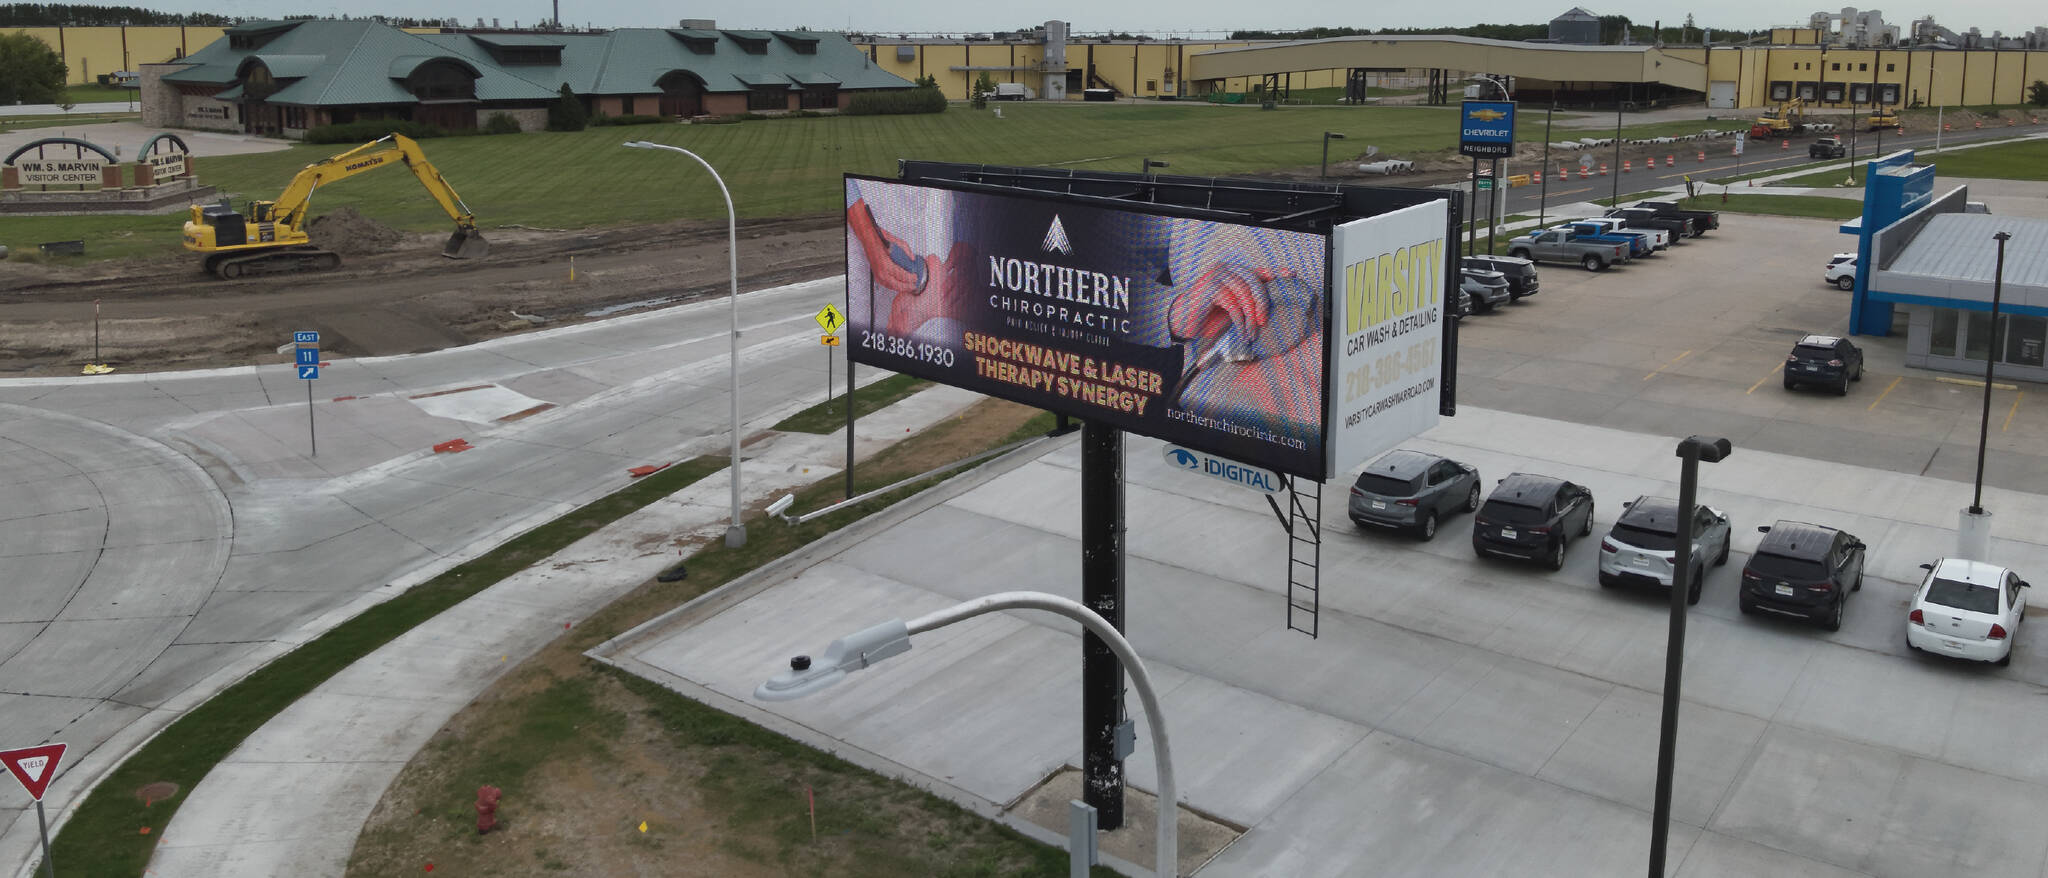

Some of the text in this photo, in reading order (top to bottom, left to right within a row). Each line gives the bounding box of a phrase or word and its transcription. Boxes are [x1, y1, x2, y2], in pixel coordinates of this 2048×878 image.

[1464, 129, 1509, 137] CHEVROLET
[1464, 145, 1507, 153] NEIGHBORS
[22, 163, 100, 172] WM. S. MARVIN
[26, 174, 97, 182] VISITOR CENTER
[345, 157, 384, 171] KOMATSU
[989, 255, 1131, 313] NORTHERN
[1346, 239, 1442, 335] VARSITY
[990, 294, 1131, 334] CHIROPRACTIC
[297, 333, 315, 341] EAST
[862, 330, 954, 368] 218.386.1930
[1347, 307, 1437, 357] CAR WASH & DETAILING
[303, 351, 312, 362] 11
[964, 332, 1163, 395] SHOCKWAVE & LASER
[975, 355, 1149, 415] THERAPY SYNERGY
[1167, 408, 1307, 450] northernchiroclinic.com
[1204, 458, 1275, 492] iDIGITAL
[23, 760, 44, 769] YIELD
